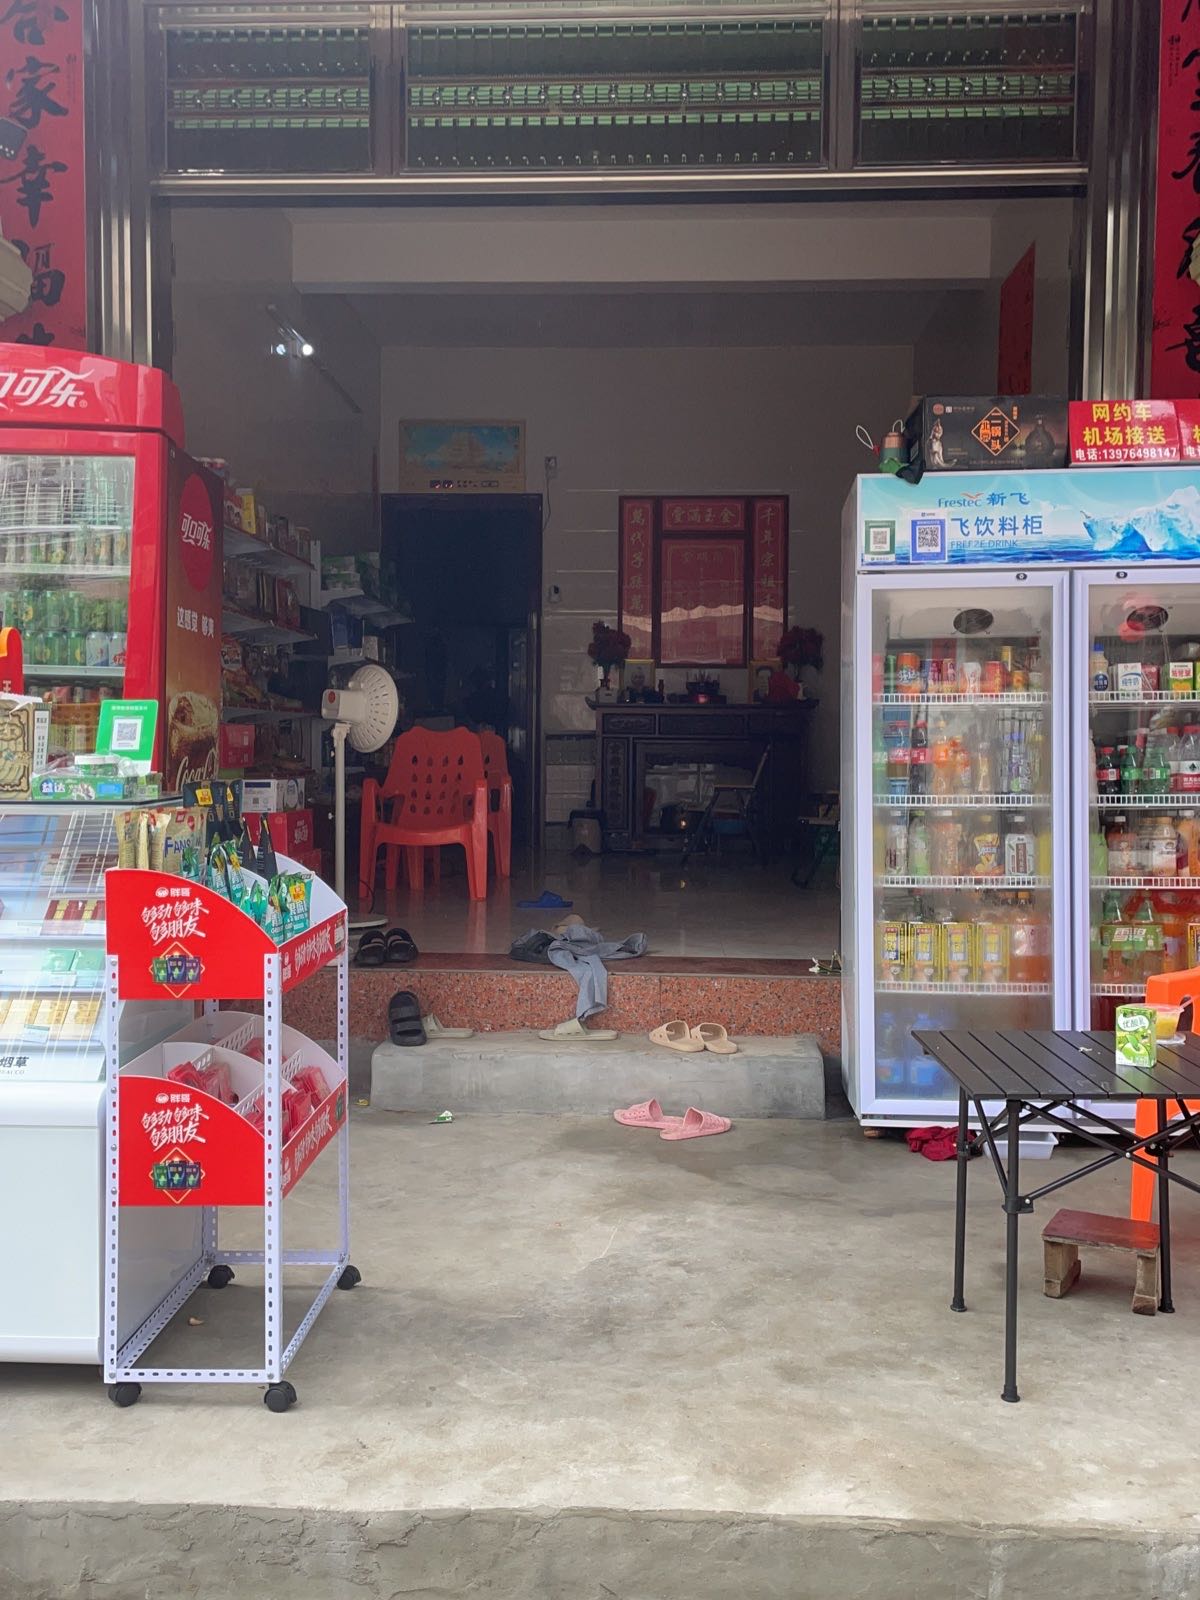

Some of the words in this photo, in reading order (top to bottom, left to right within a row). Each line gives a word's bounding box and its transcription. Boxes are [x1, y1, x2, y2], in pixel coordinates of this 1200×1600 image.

[1092, 403, 1153, 422] 网约车
[1083, 425, 1166, 447] 机场接送
[1075, 447, 1177, 461] 电话:13976498147
[938, 498, 982, 508] Frestec
[986, 492, 1031, 507] 新飞
[181, 513, 213, 551] 可口可乐
[988, 539, 1018, 548] DRINK
[176, 606, 199, 633] 这感觉
[41, 782, 66, 793] 益达
[149, 915, 207, 947] 够朋友
[149, 1120, 207, 1152] 够朋友
